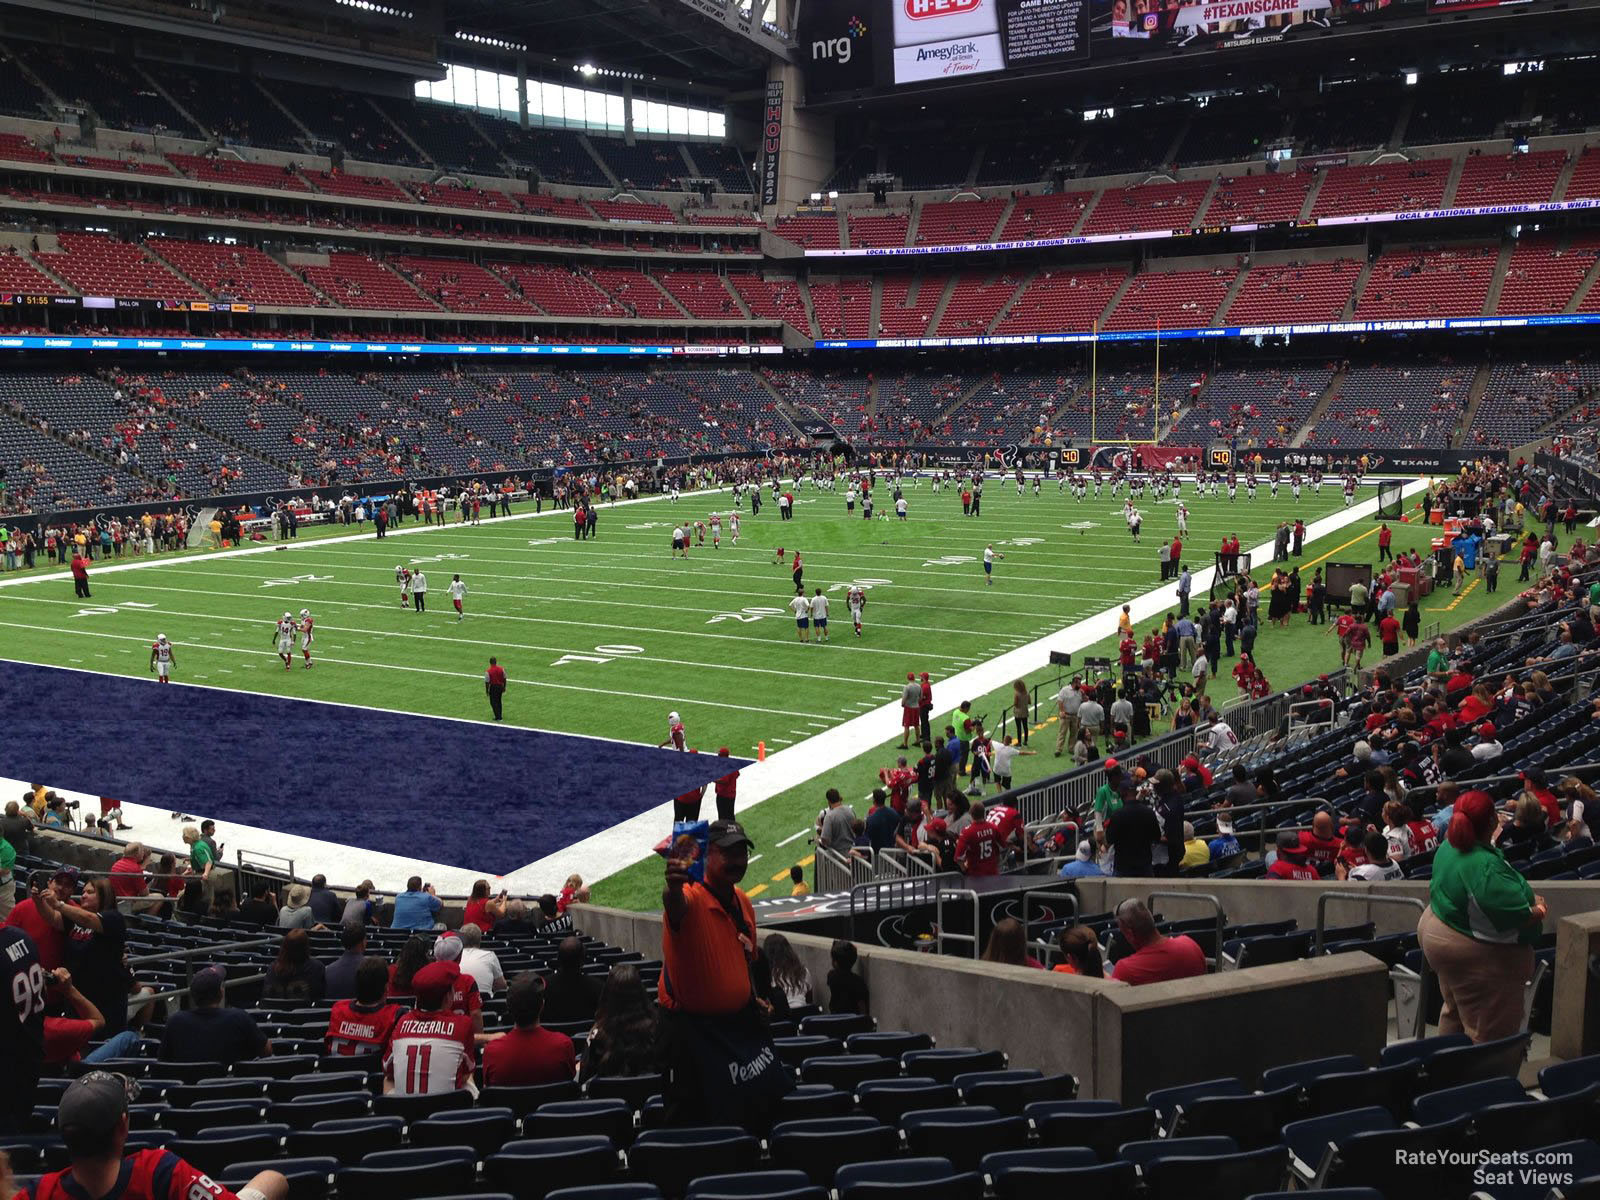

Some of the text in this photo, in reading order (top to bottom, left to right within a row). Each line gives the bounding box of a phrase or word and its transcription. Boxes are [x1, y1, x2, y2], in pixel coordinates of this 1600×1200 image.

[1203, 0, 1298, 20] #TEXANSCARE
[812, 37, 851, 63] nrg
[1224, 34, 1283, 48] MITSUBISHI ELECTRIC
[916, 42, 976, 61] AmegyBank
[766, 106, 781, 153] HOU
[1433, 209, 1476, 217] NATIONAL
[1063, 451, 1077, 462] 40
[1213, 452, 1229, 463] 40
[712, 607, 785, 622] 20
[560, 645, 644, 664] 10
[977, 828, 993, 838] FLOYD
[980, 840, 993, 859] 15
[5, 939, 29, 962] WATT
[13, 963, 44, 1023] 99
[339, 1021, 375, 1038] CUSHING
[400, 1020, 454, 1036] FITZGERALD
[406, 1045, 431, 1094] 11
